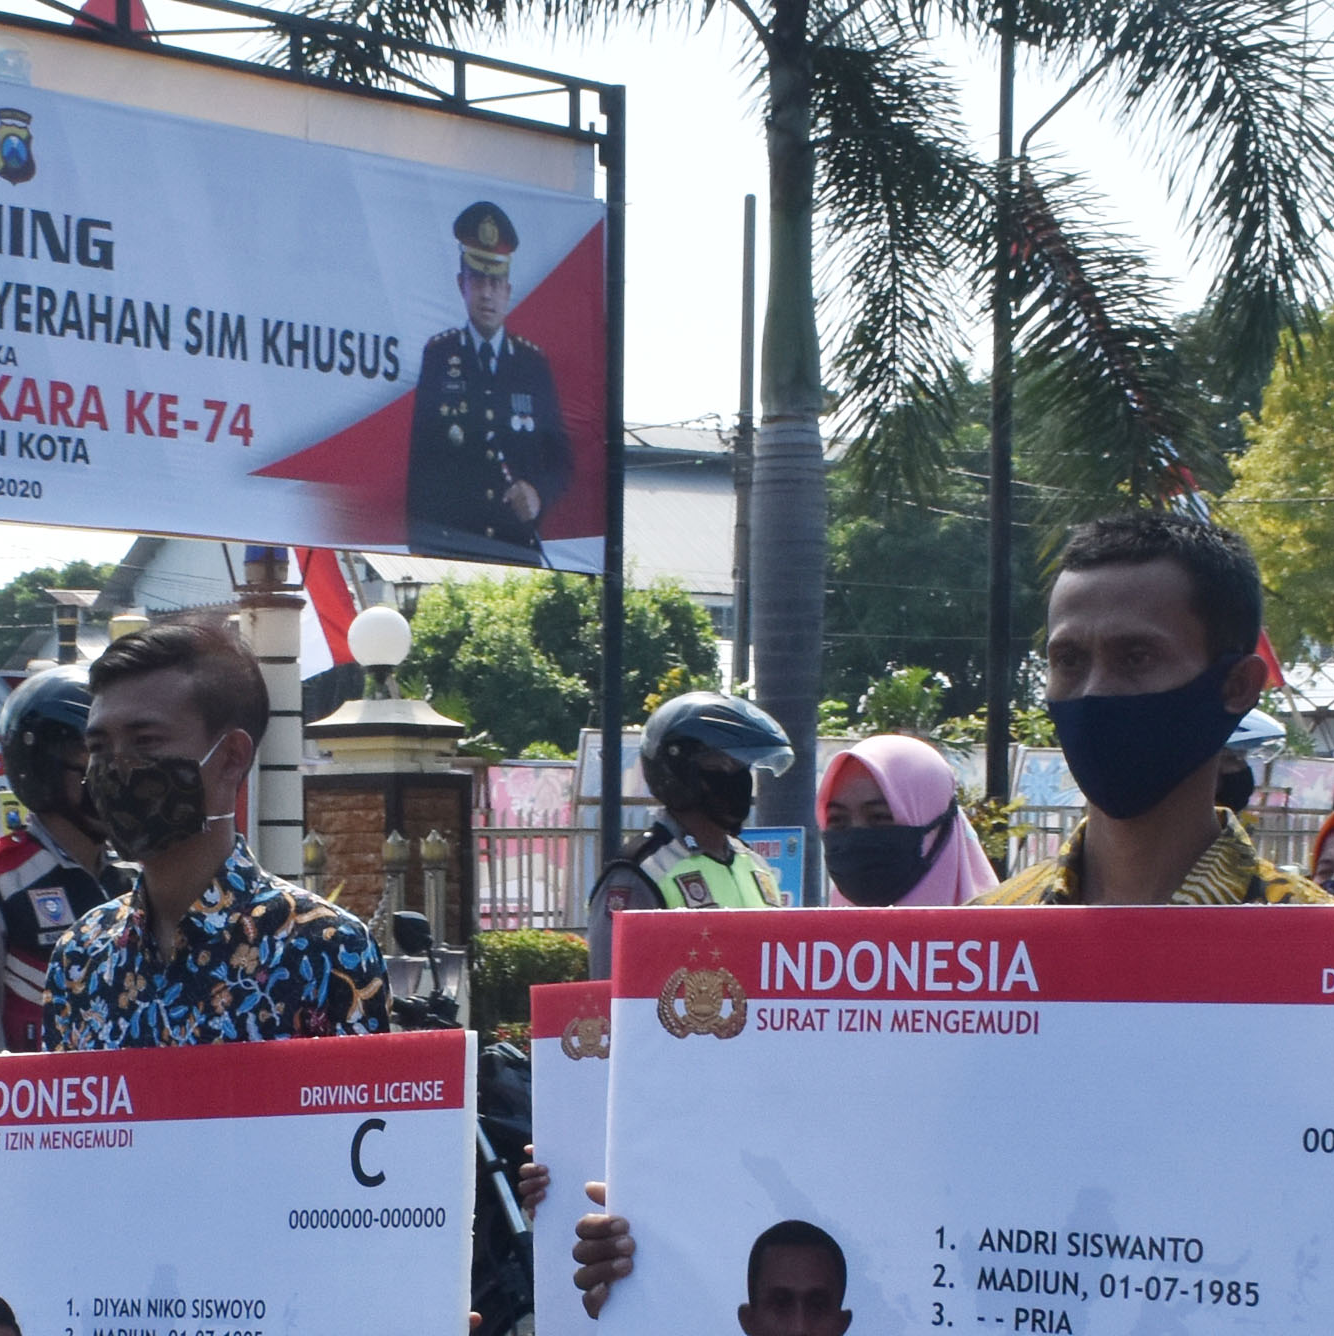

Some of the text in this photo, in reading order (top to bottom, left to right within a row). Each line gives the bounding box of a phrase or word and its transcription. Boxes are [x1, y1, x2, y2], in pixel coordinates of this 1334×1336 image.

[185, 308, 247, 361] SIM
[262, 320, 400, 381] KHUSUS
[125, 390, 254, 446] KE-74
[17, 433, 90, 465] KOTA
[761, 940, 1039, 992] INDONESIA
[756, 1009, 1039, 1034] SURAT IZIN MENGEMUDI
[300, 1081, 444, 1107] DRIVING LICENSE
[5, 1130, 34, 1150] IZIN
[40, 1129, 133, 1150] MENGEMUDI
[350, 1118, 386, 1188] C
[289, 1208, 445, 1229] 00000000-000000
[979, 1228, 1203, 1263] ANDRI SISWANTO
[978, 1267, 1259, 1307] MADIUN, 01-07-1985
[93, 1298, 266, 1320] DIYAN NIKO SISWOYO
[1014, 1308, 1072, 1336] PRIA
